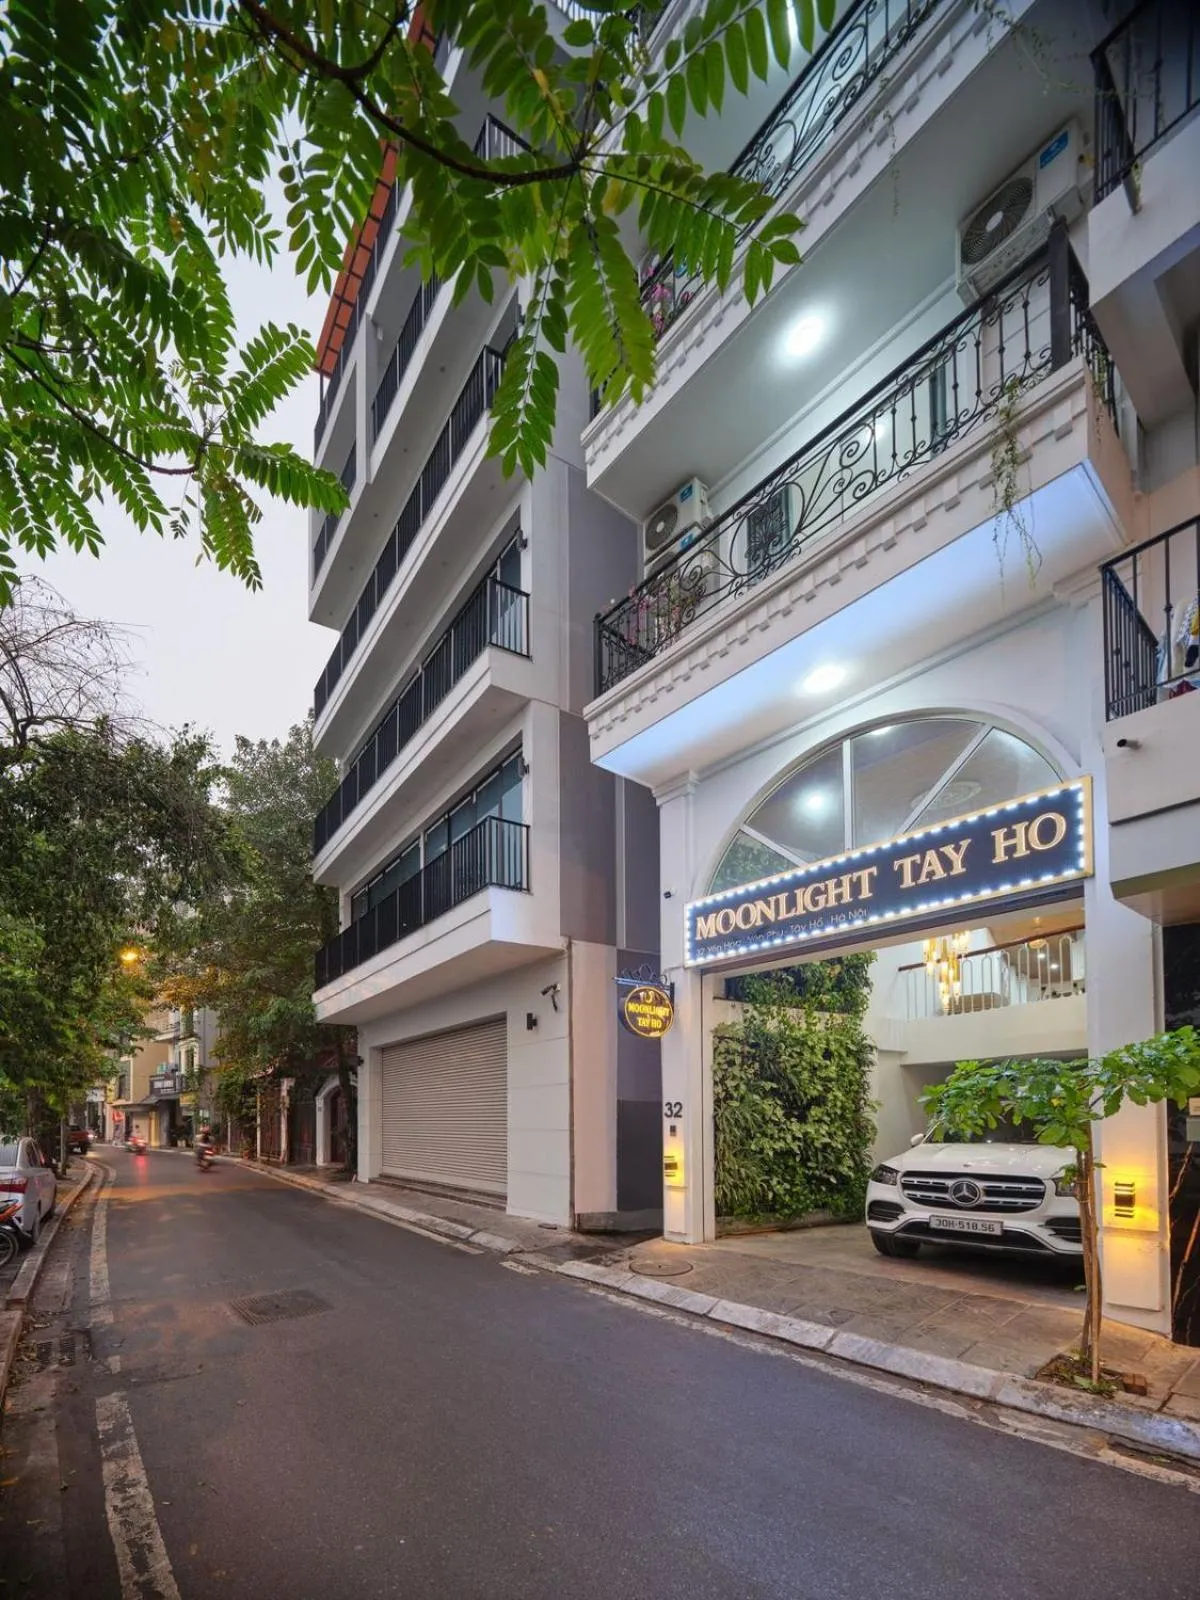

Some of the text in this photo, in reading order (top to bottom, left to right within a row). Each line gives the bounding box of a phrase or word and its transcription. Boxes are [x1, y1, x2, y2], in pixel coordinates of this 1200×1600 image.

[695, 812, 1066, 940] MOONLIGHT TAY HO
[628, 1002, 670, 1017] MOONLIGHT
[651, 1018, 662, 1029] HO
[664, 1101, 683, 1119] 32
